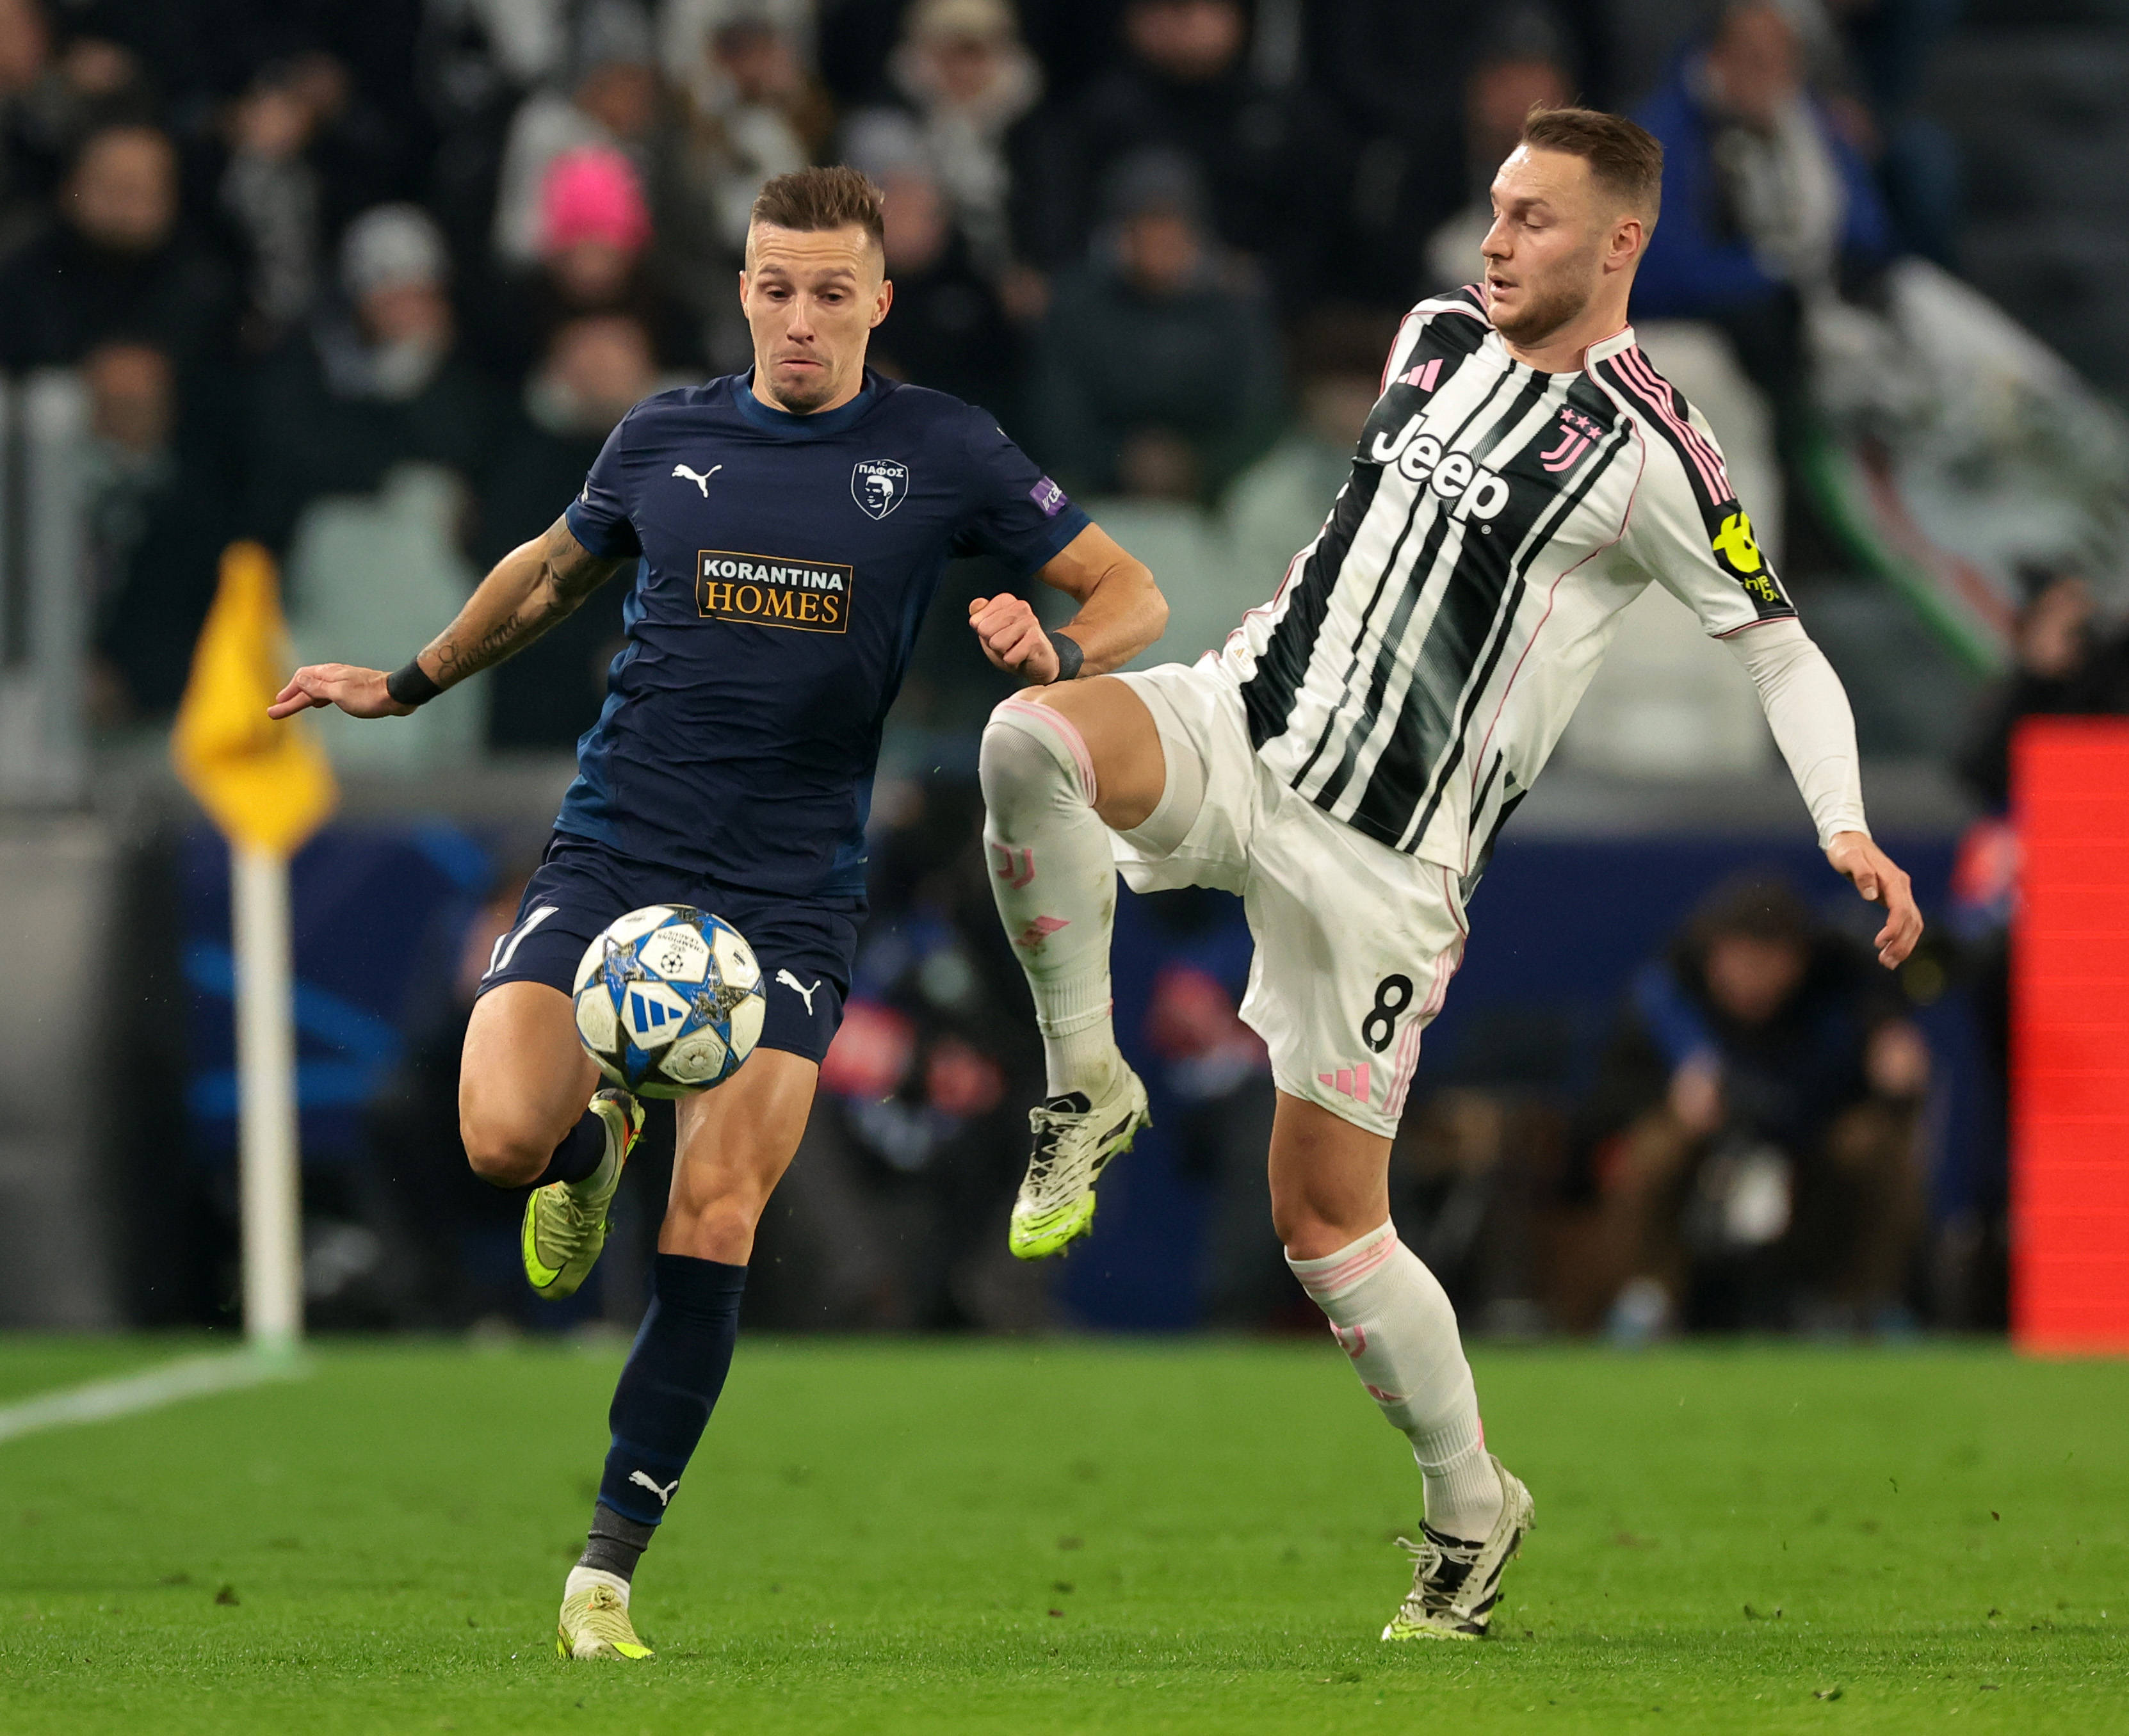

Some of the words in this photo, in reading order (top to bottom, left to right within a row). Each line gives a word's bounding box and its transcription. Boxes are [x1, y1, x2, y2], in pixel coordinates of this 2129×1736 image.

[859, 464, 904, 478] ΠΑΦΟΣ
[1371, 413, 1510, 521] Jeep
[704, 559, 843, 591] KORANTINA
[706, 581, 839, 624] HOMES
[656, 933, 705, 954] CHAMPIONS
[1362, 973, 1413, 1054] 8
